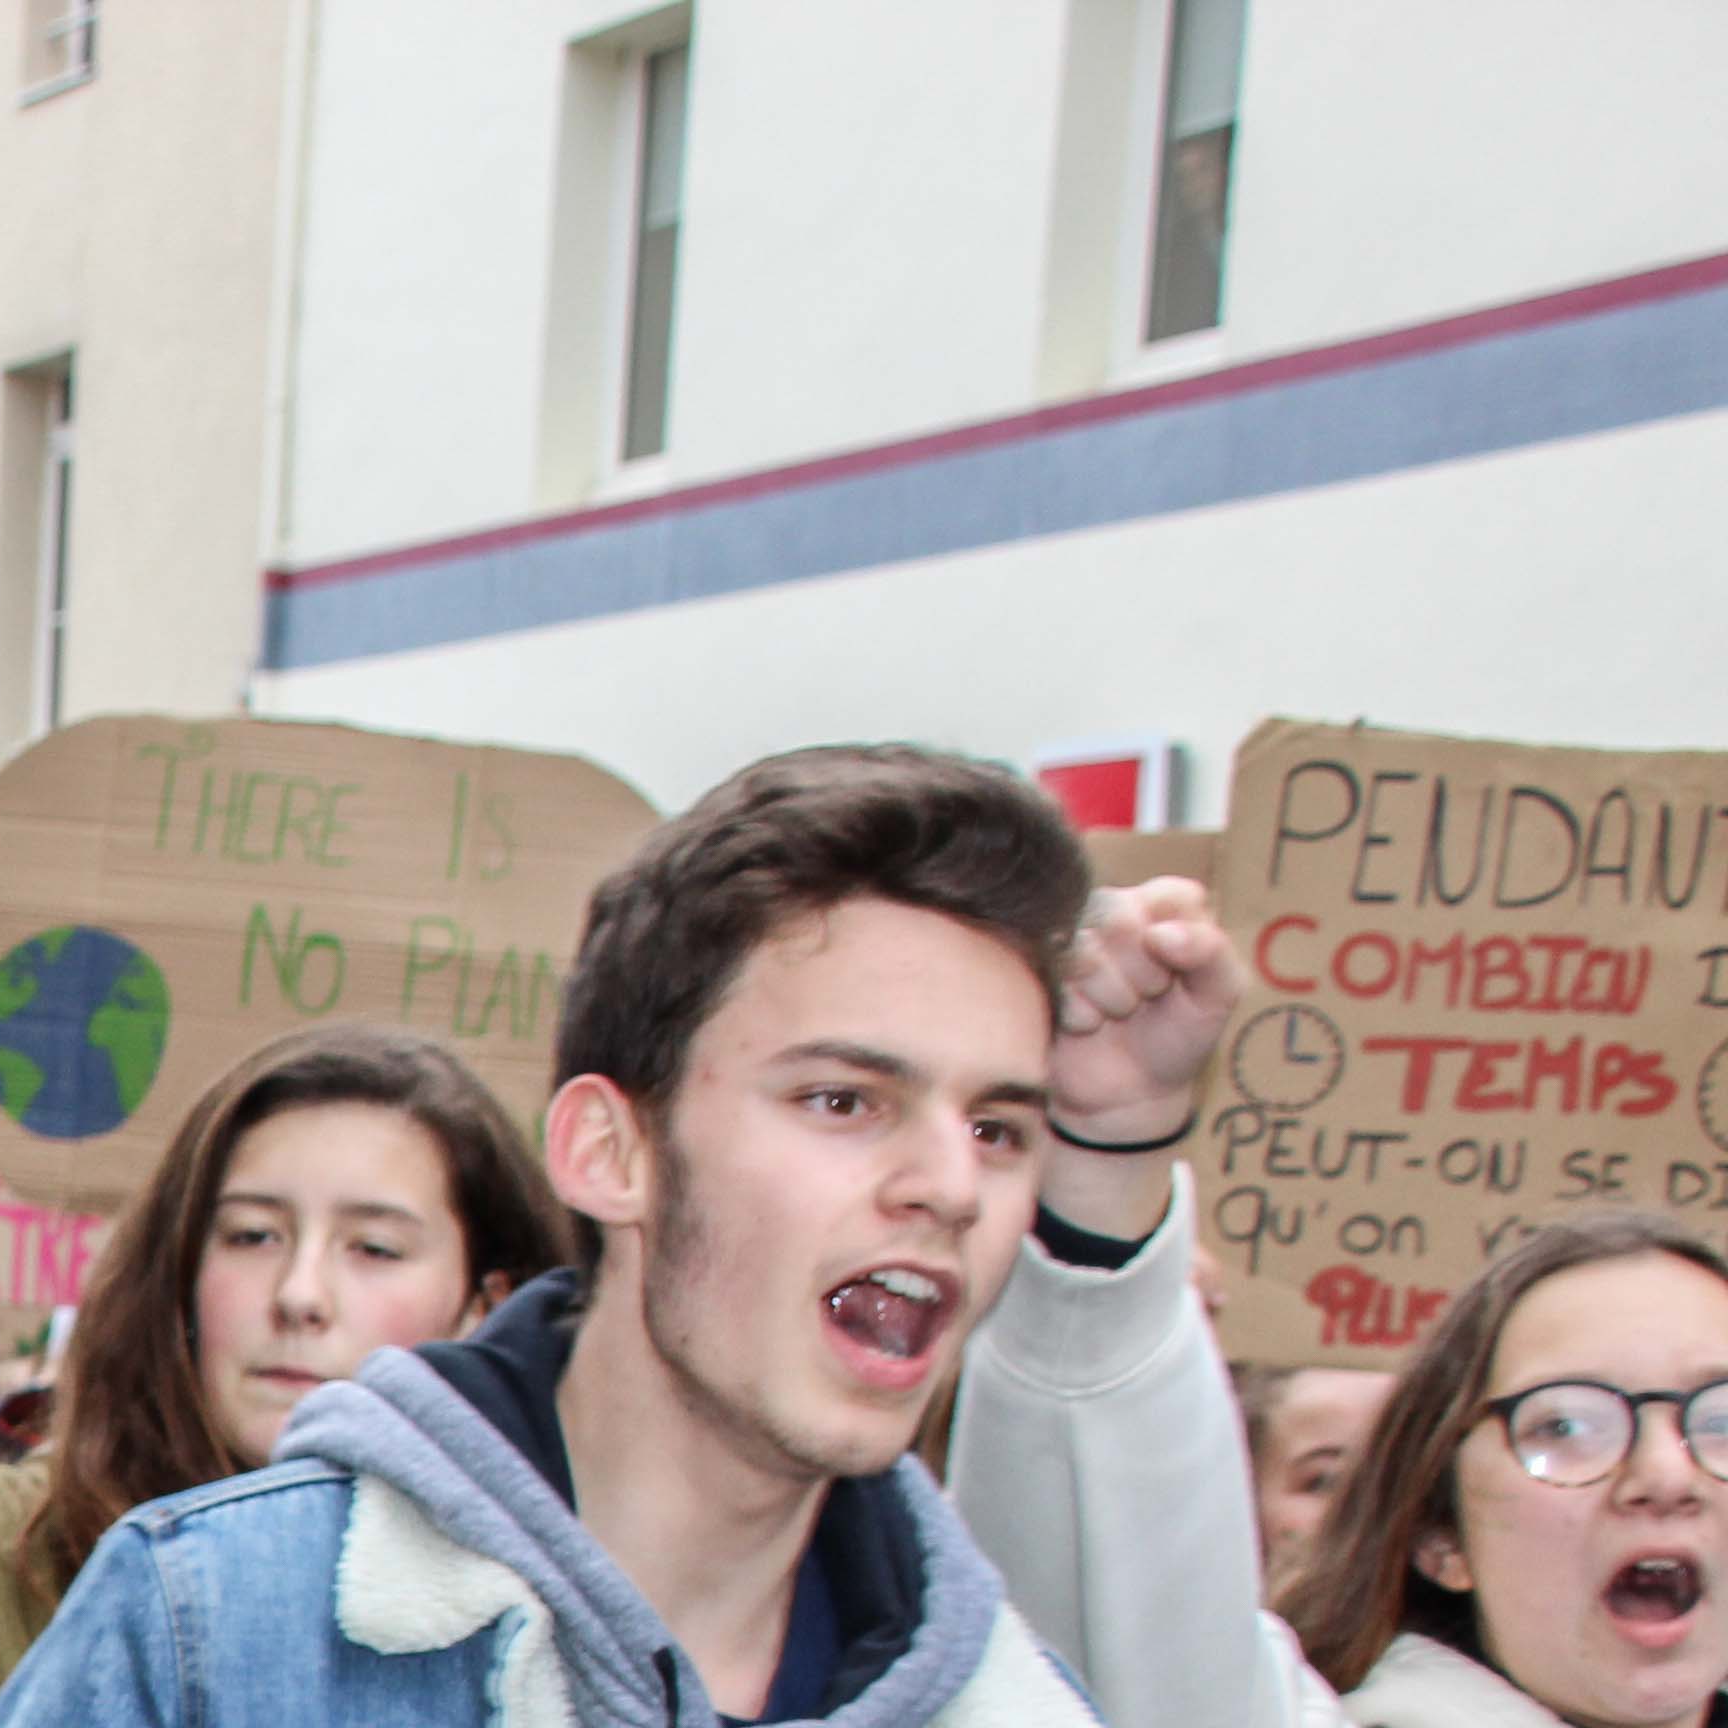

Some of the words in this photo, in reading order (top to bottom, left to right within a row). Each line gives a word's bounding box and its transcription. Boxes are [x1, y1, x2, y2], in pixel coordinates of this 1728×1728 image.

[136, 735, 364, 868] THERE
[447, 770, 516, 881] IS
[1267, 759, 1728, 911] PENDAN
[1361, 1035, 1679, 1117] TEMPS
[1555, 1149, 1632, 1200] SE
